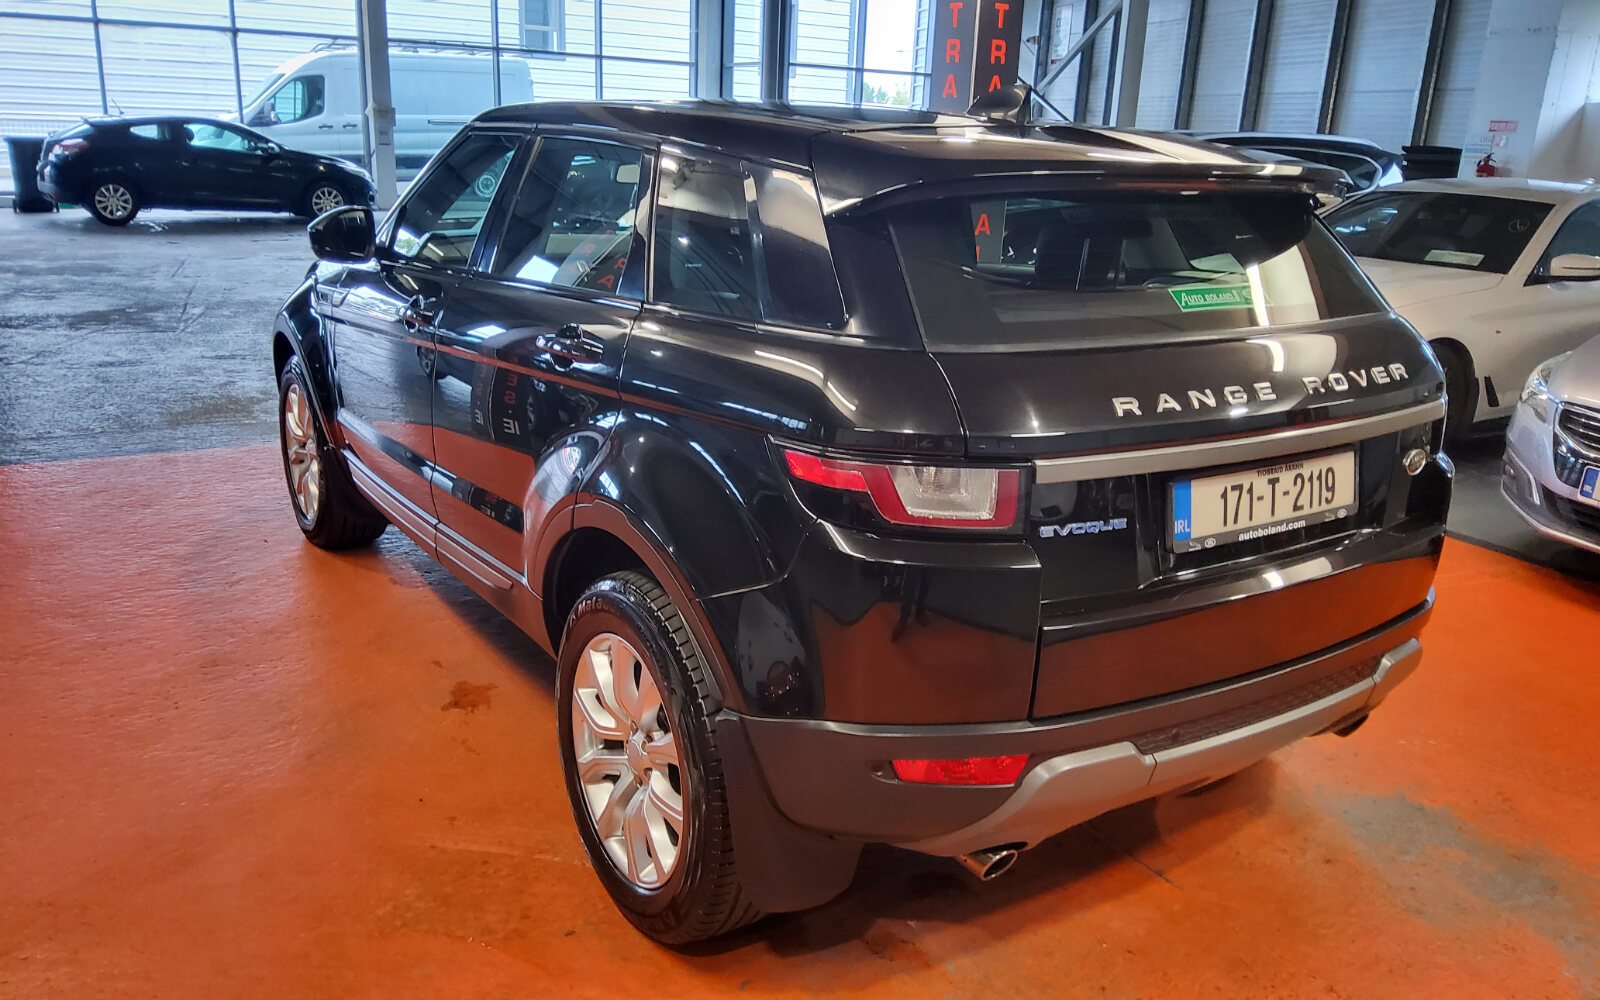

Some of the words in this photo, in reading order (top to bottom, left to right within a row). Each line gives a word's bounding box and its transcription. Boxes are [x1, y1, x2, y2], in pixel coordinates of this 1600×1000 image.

[941, 2, 963, 110] TRA
[1111, 381, 1277, 417] RANGE
[1301, 362, 1409, 397] ROVER
[1256, 466, 1284, 477] TIOBRAID
[1220, 466, 1336, 527] 171-T-2119
[1040, 517, 1128, 538] EVOQUE
[1174, 518, 1191, 535] IRL
[1238, 519, 1306, 542] autoboland.com
